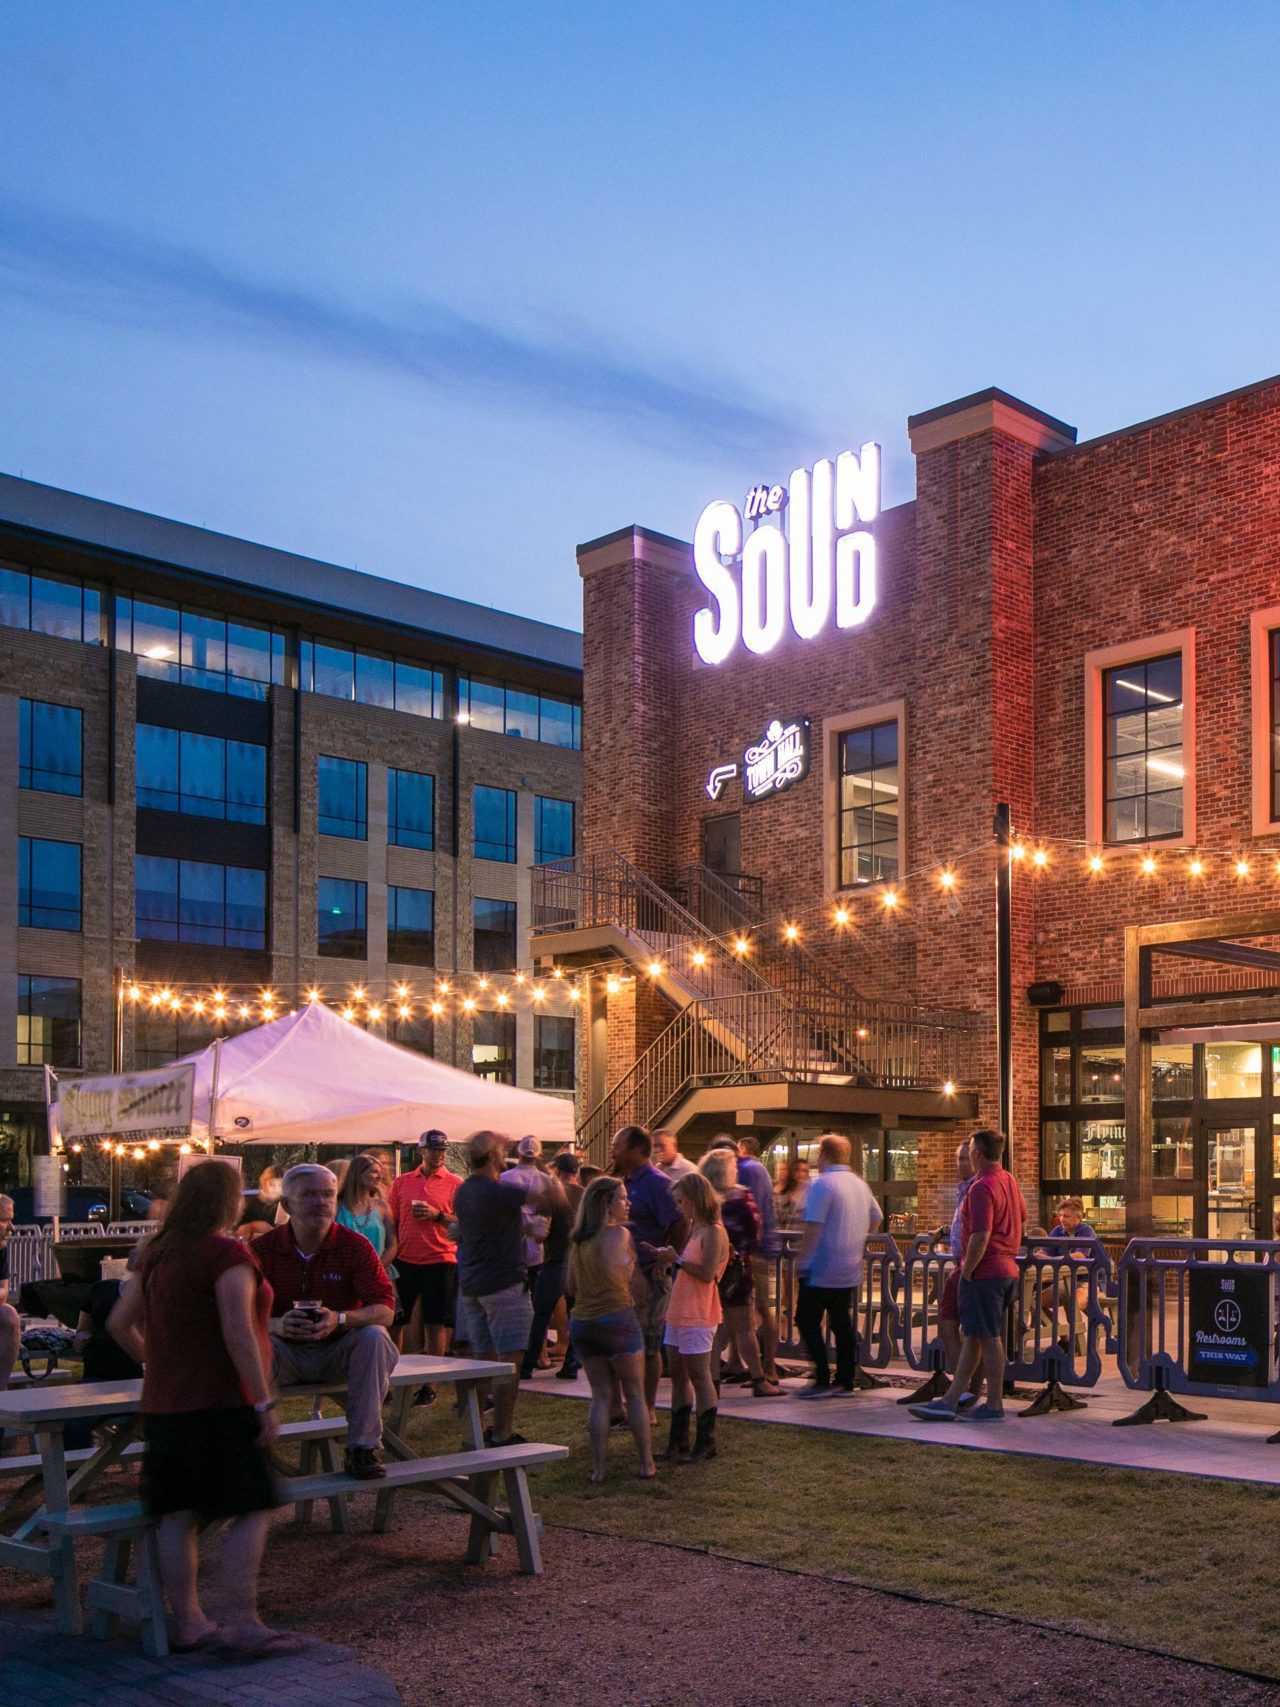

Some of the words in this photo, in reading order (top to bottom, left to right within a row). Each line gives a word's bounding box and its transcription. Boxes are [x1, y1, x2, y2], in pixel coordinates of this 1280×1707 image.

[744, 484, 788, 520] the
[746, 750, 775, 791] TOWN
[1195, 1330, 1248, 1346] Restrooms
[1199, 1351, 1224, 1359] THIS
[1224, 1352, 1248, 1361] WAY
